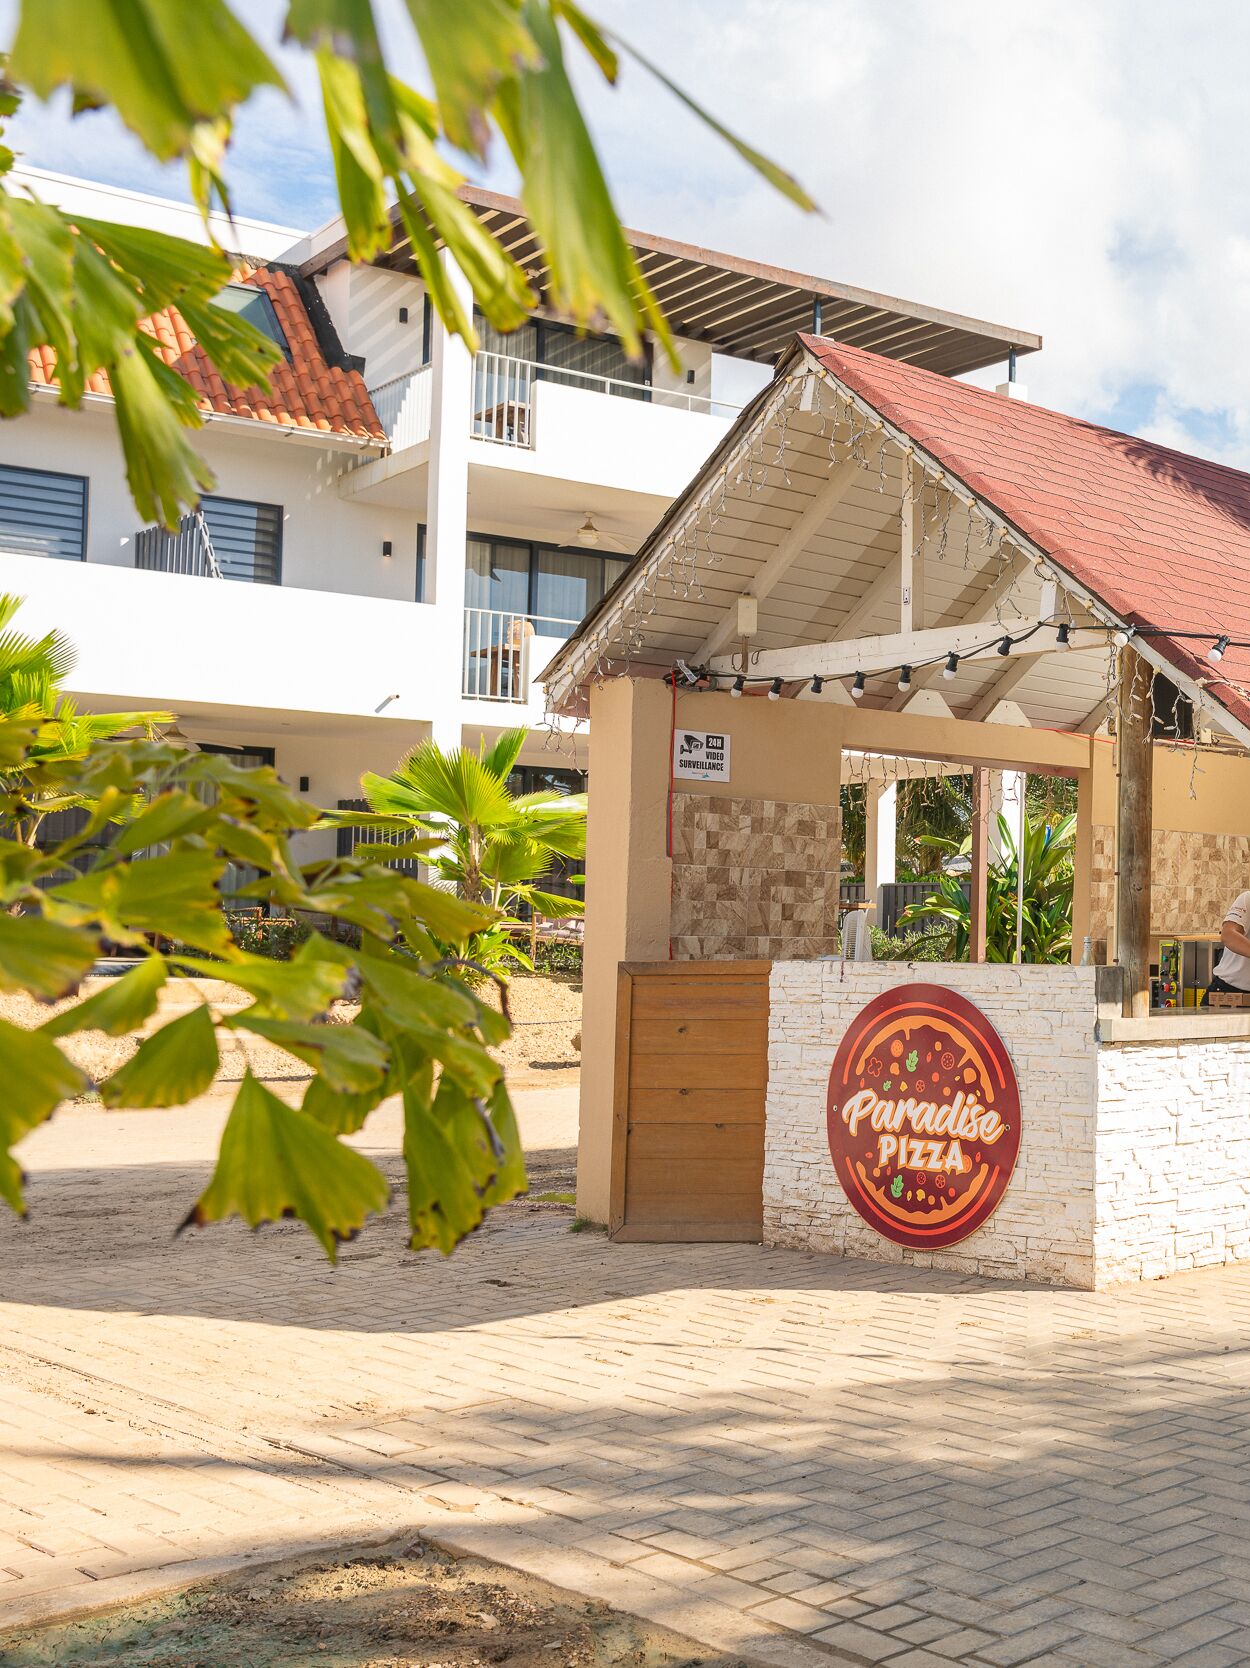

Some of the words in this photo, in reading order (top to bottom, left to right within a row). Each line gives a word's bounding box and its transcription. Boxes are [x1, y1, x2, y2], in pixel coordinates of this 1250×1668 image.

[708, 738, 722, 748] 24H
[705, 751, 724, 761] VIDEO
[679, 759, 724, 771] SURVEILLANCE
[842, 1088, 1006, 1144] Paradise
[877, 1134, 967, 1174] PIZZA
